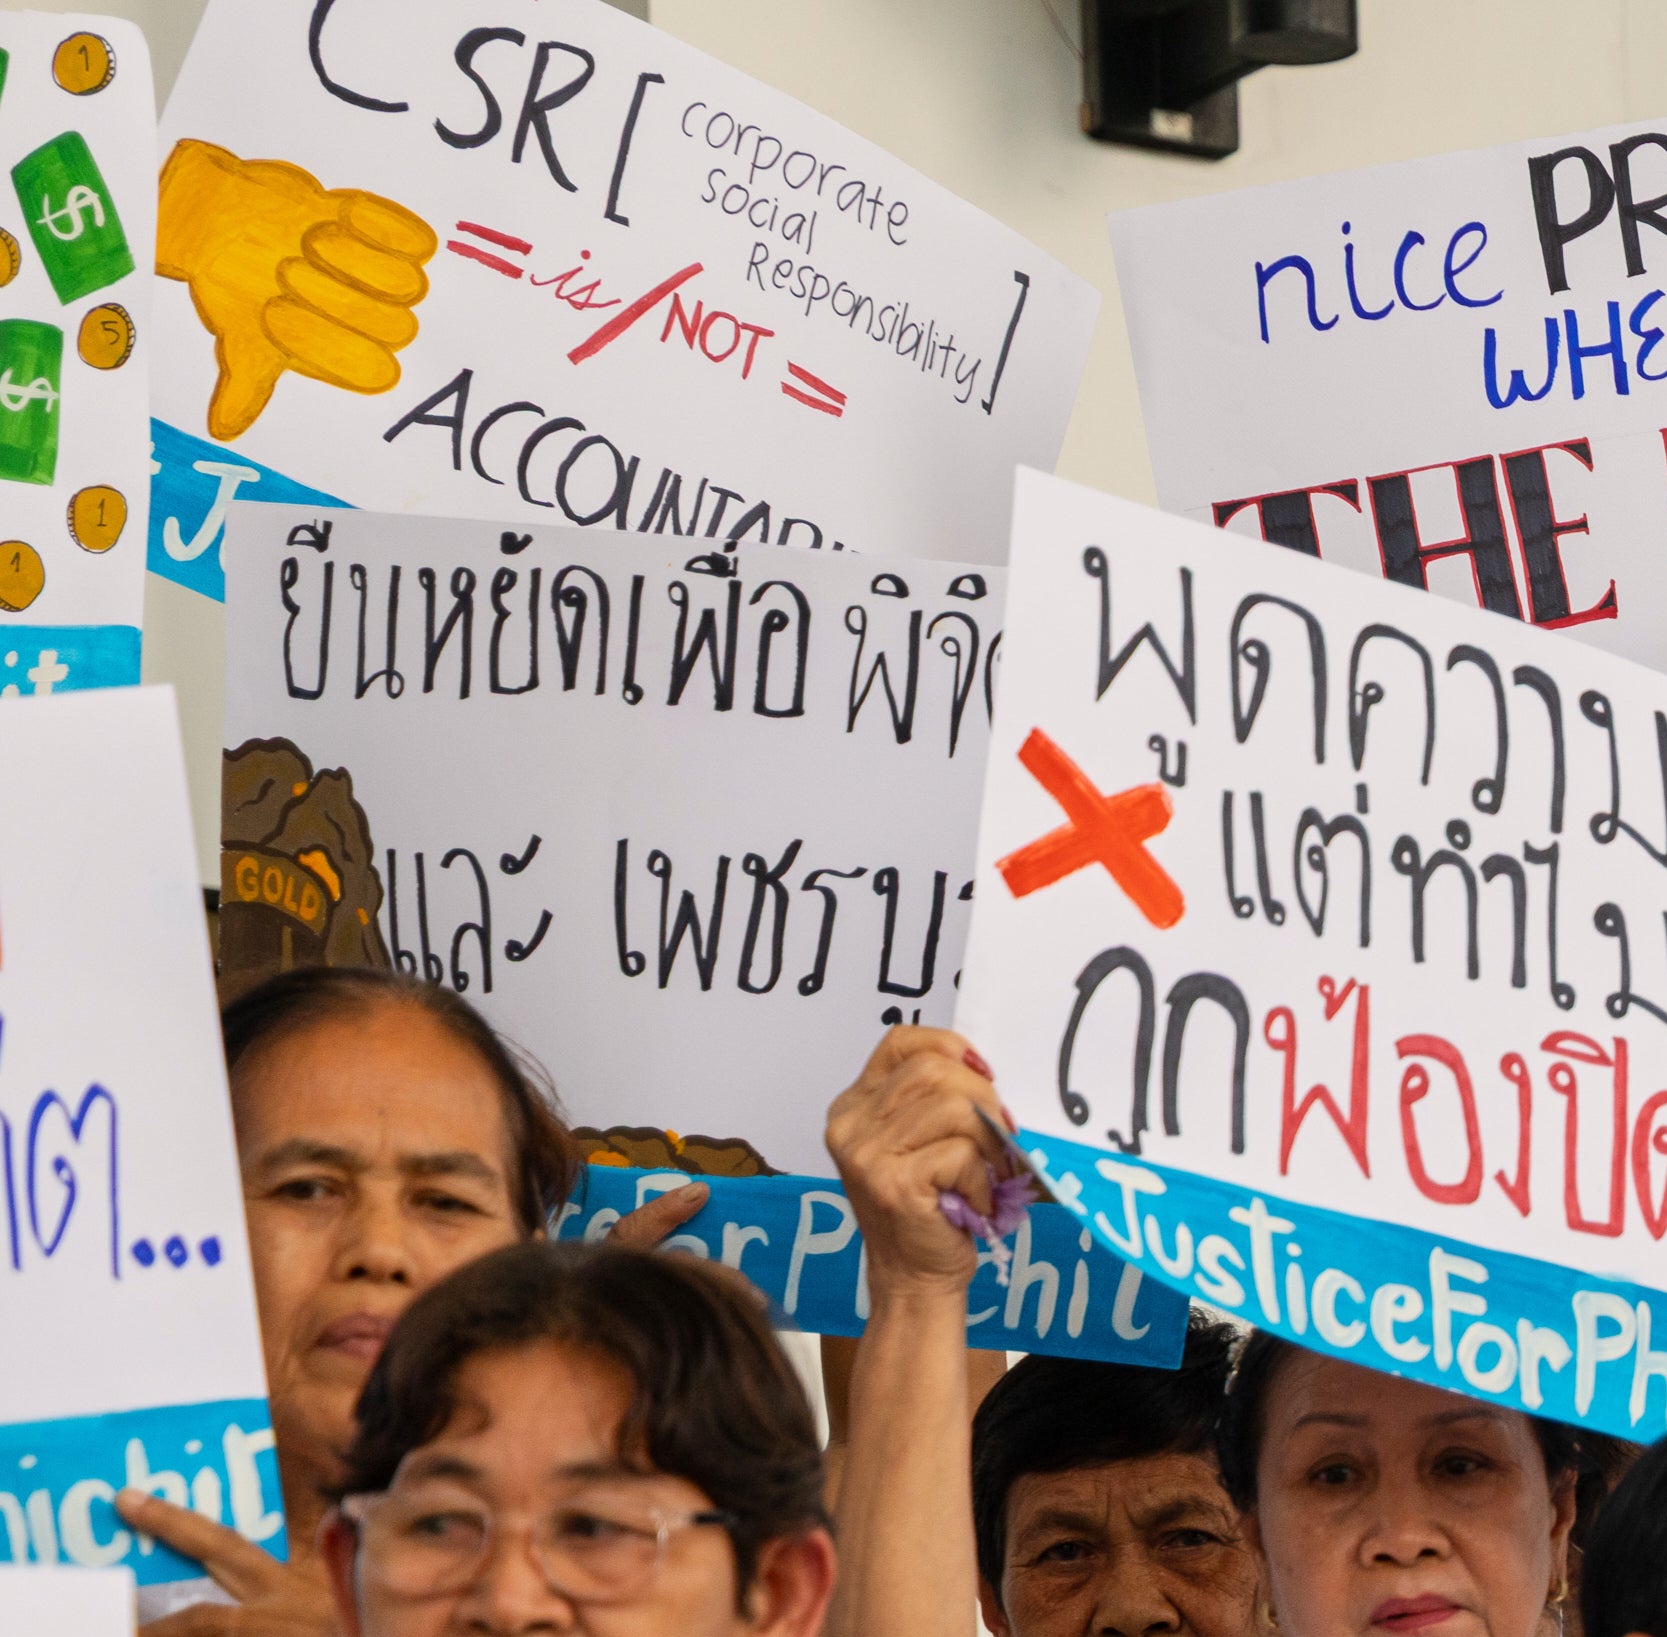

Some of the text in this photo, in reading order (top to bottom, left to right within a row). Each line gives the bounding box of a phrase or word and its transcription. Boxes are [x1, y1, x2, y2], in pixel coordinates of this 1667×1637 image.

[680, 97, 912, 247] corporate
[701, 168, 818, 257] social
[1253, 221, 1504, 344] nice
[235, 855, 324, 922] GOLD
[614, 838, 977, 1027] เพชรบู
